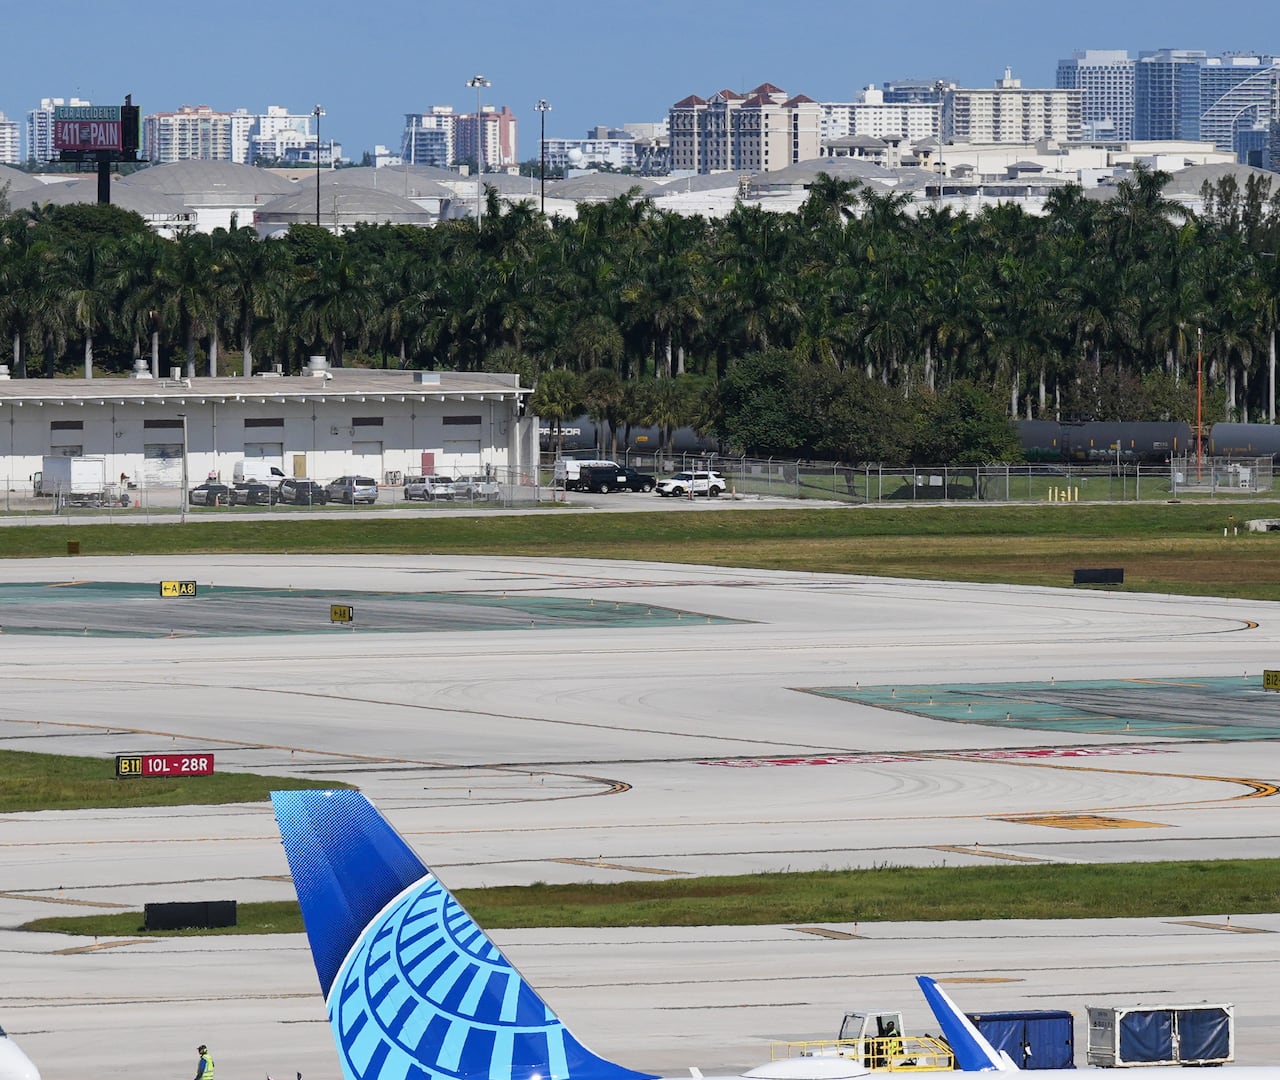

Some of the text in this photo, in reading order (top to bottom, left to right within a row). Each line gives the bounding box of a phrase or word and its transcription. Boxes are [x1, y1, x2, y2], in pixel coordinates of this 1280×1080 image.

[60, 107, 74, 118] CAR
[63, 123, 80, 145] 411
[90, 123, 118, 145] PAIN
[171, 583, 195, 594] A A8
[1266, 674, 1279, 686] B12
[121, 758, 140, 773] B11
[148, 758, 171, 772] 10L
[181, 757, 208, 771] 28R
